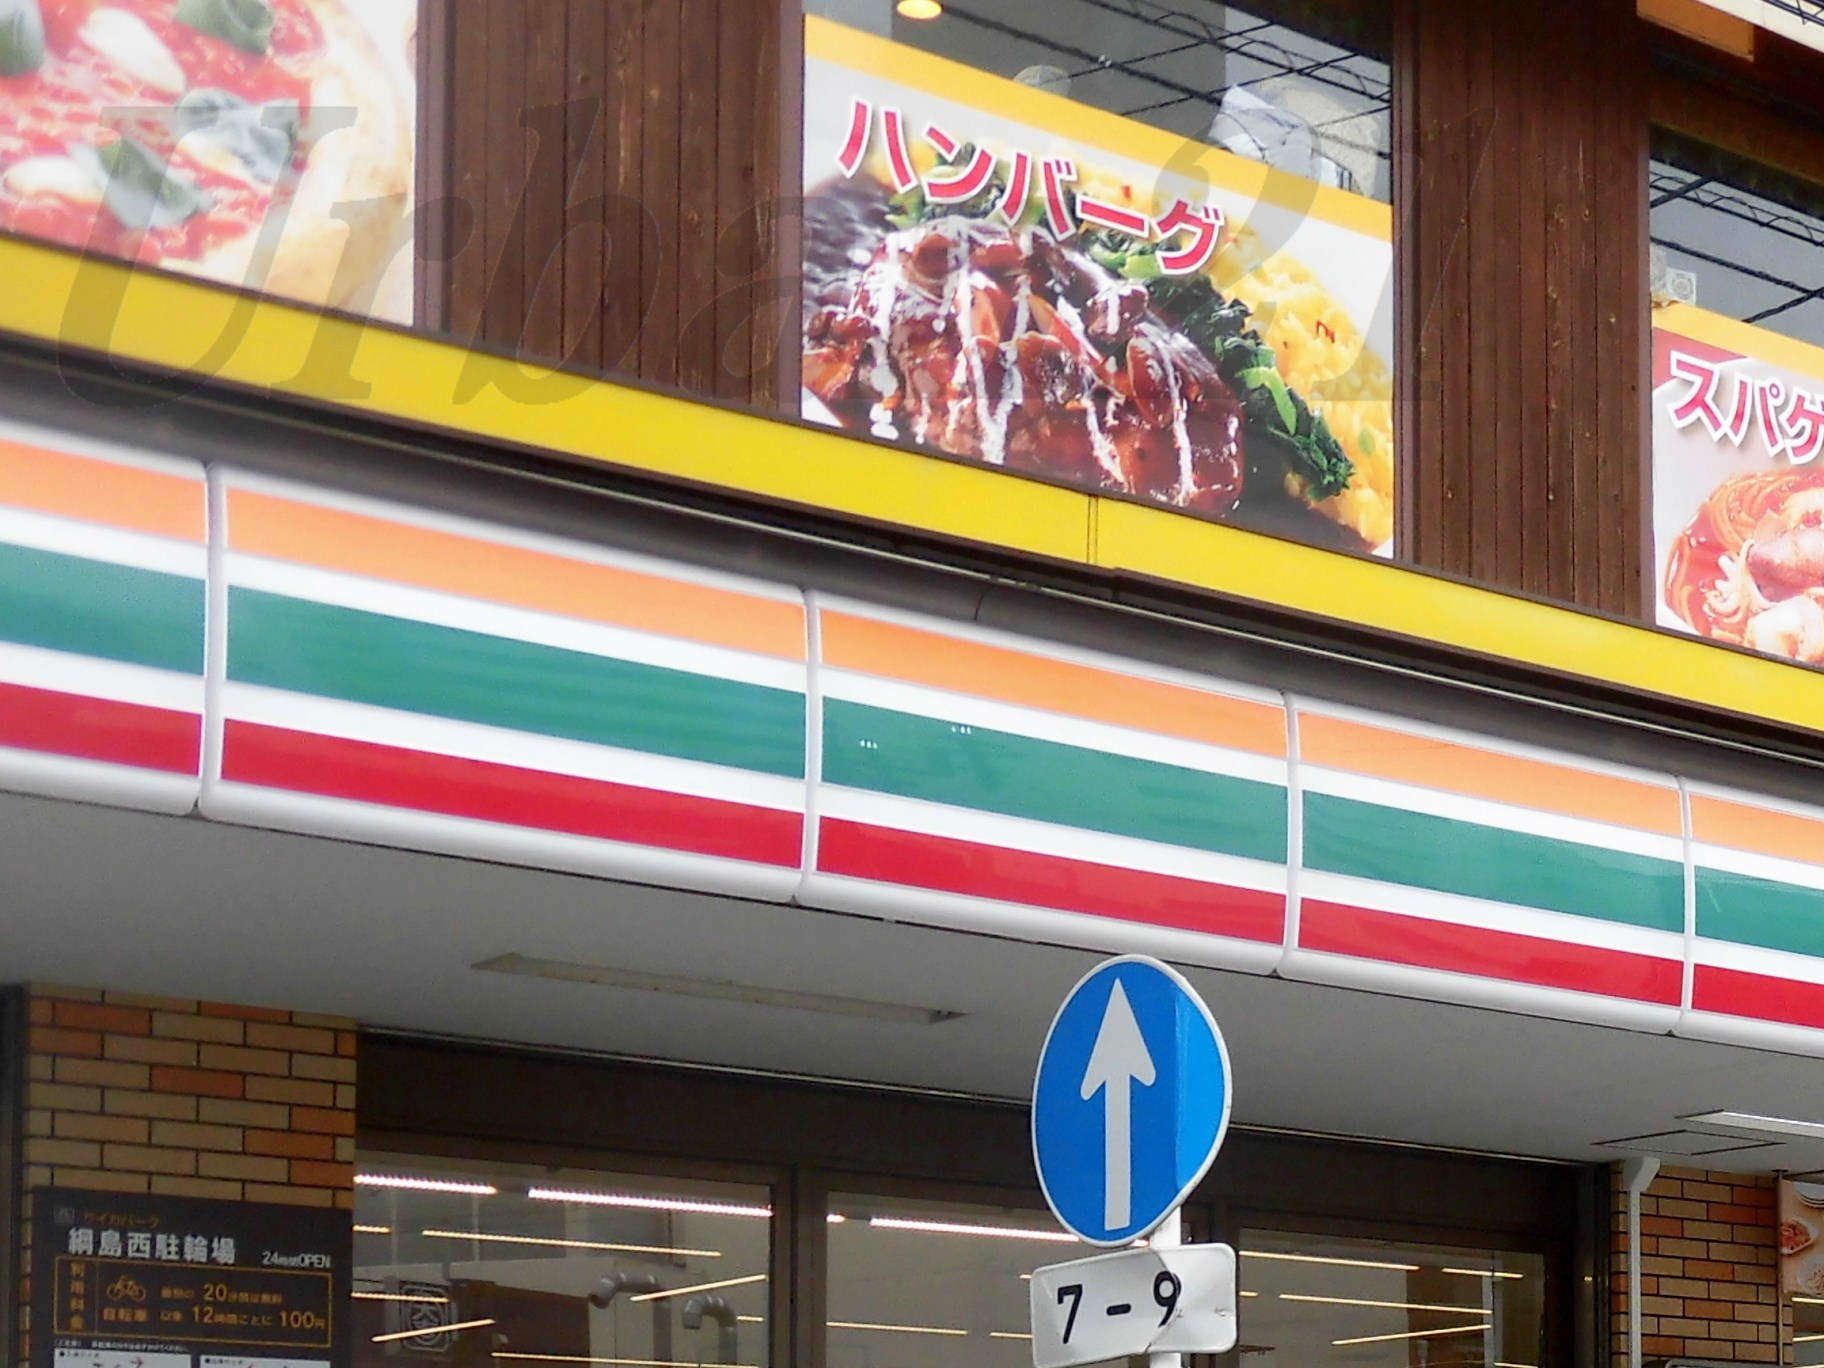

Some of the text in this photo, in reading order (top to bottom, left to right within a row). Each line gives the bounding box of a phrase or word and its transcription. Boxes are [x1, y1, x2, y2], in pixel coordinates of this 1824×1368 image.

[836, 97, 1224, 275] ハンバーグ
[68, 1227, 236, 1265] 綱島西駐輪場
